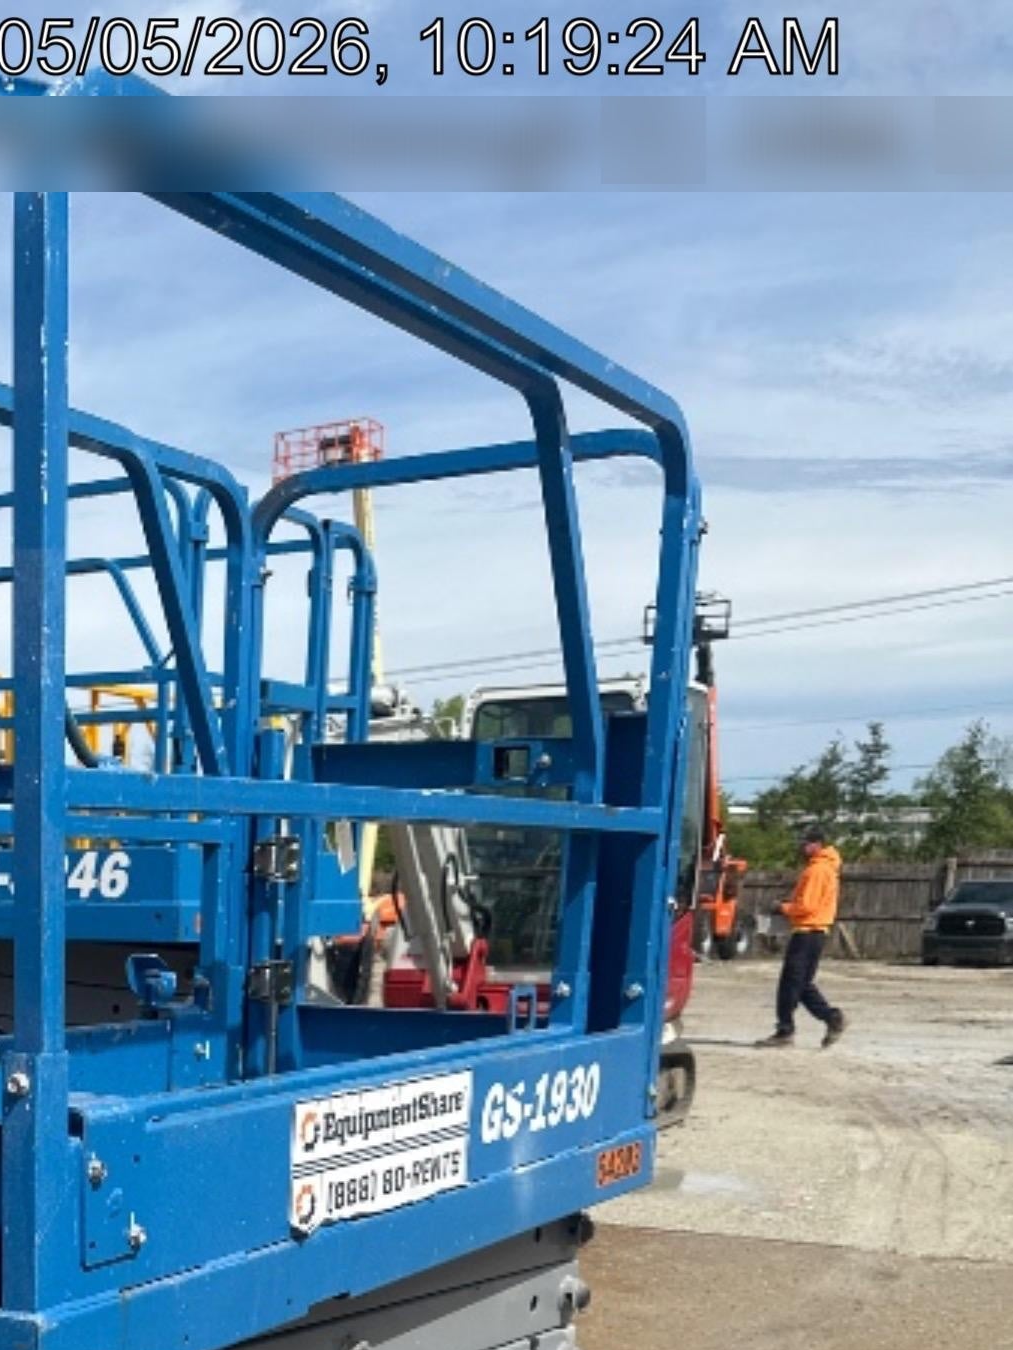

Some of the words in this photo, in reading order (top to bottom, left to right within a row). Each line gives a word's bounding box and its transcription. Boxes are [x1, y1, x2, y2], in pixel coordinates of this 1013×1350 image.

[322, 1091, 464, 1146] EquipmentShare
[481, 1061, 601, 1144] GS-1930
[327, 1170, 378, 1213] (888)
